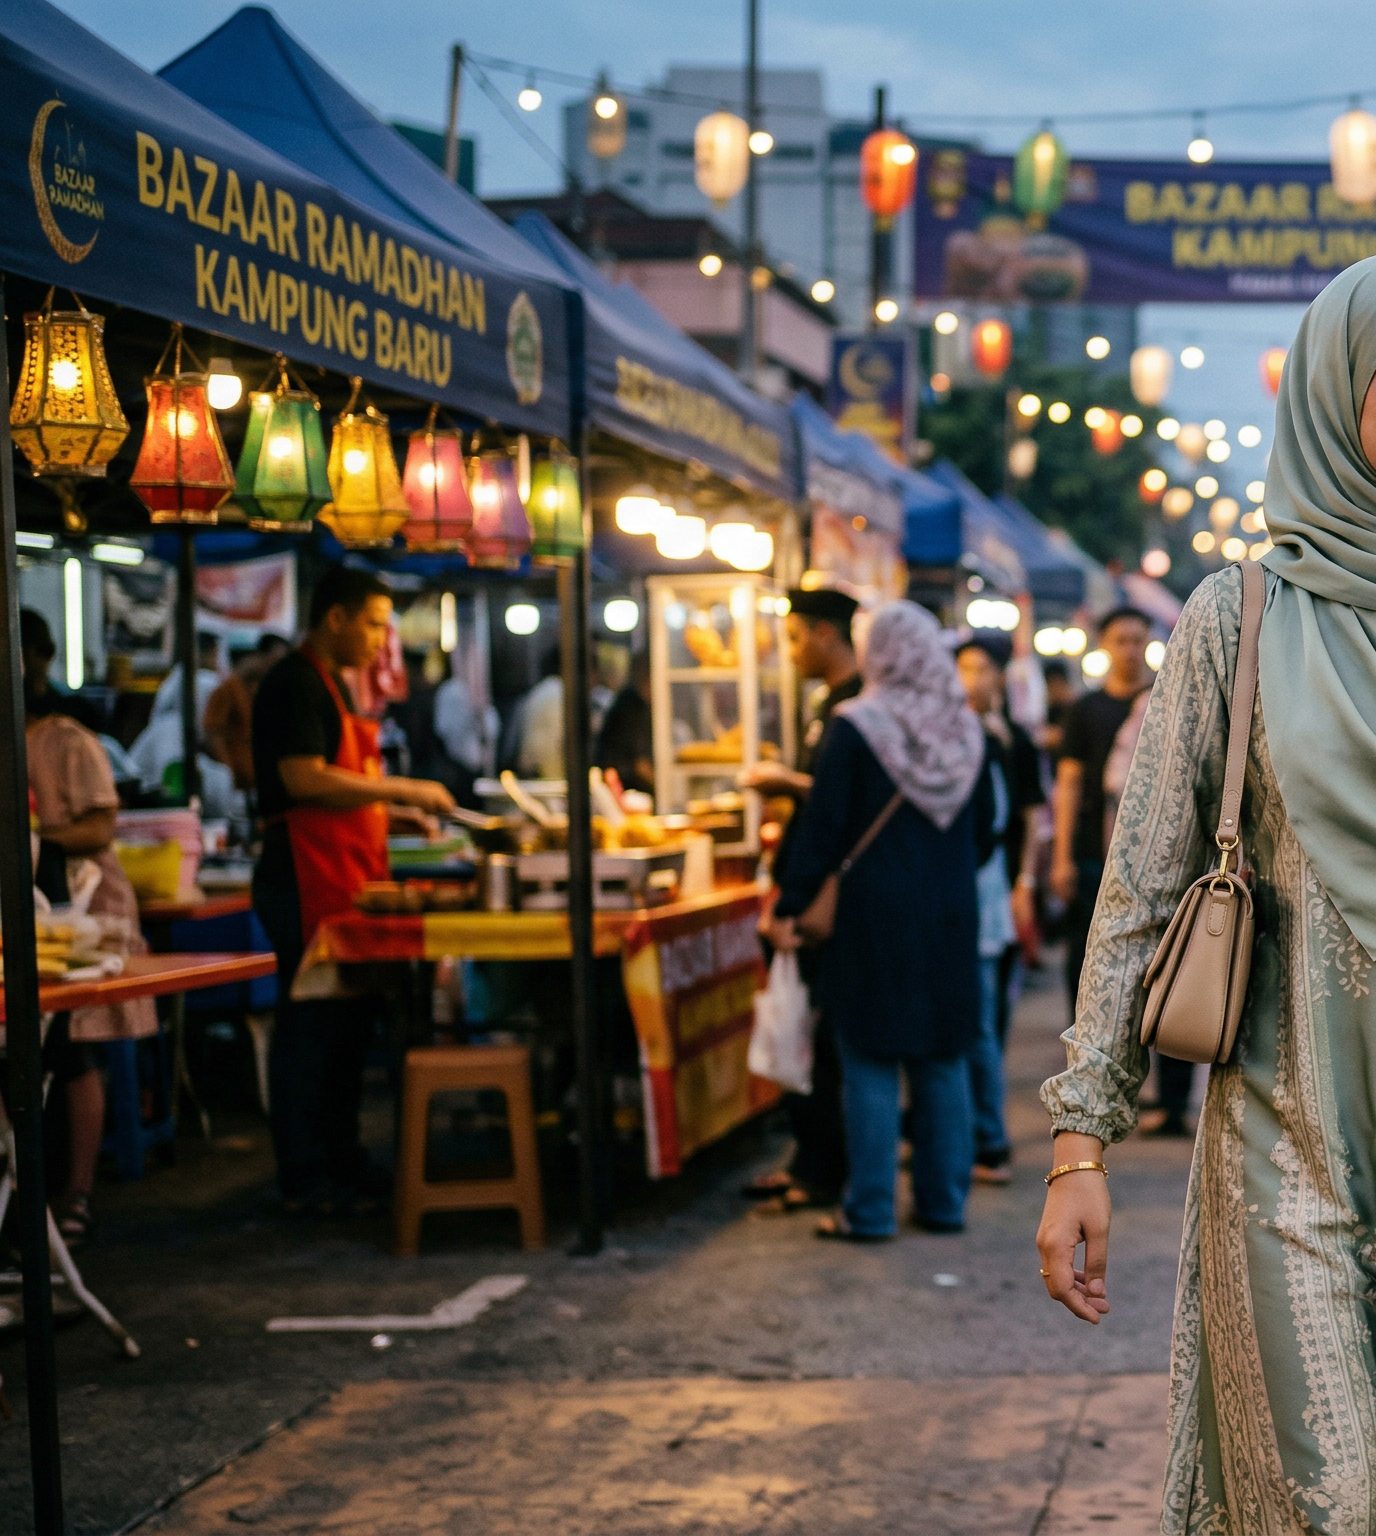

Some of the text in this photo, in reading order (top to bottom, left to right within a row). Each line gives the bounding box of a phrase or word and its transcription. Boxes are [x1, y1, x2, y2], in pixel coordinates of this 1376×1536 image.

[54, 162, 95, 196] BAZAAR
[48, 184, 105, 220] RAMADHAN
[1125, 180, 1311, 225] BAZAAR
[136, 130, 487, 336] BAZAAR RAMADHAN
[194, 243, 453, 388] KAMPUNG BARU
